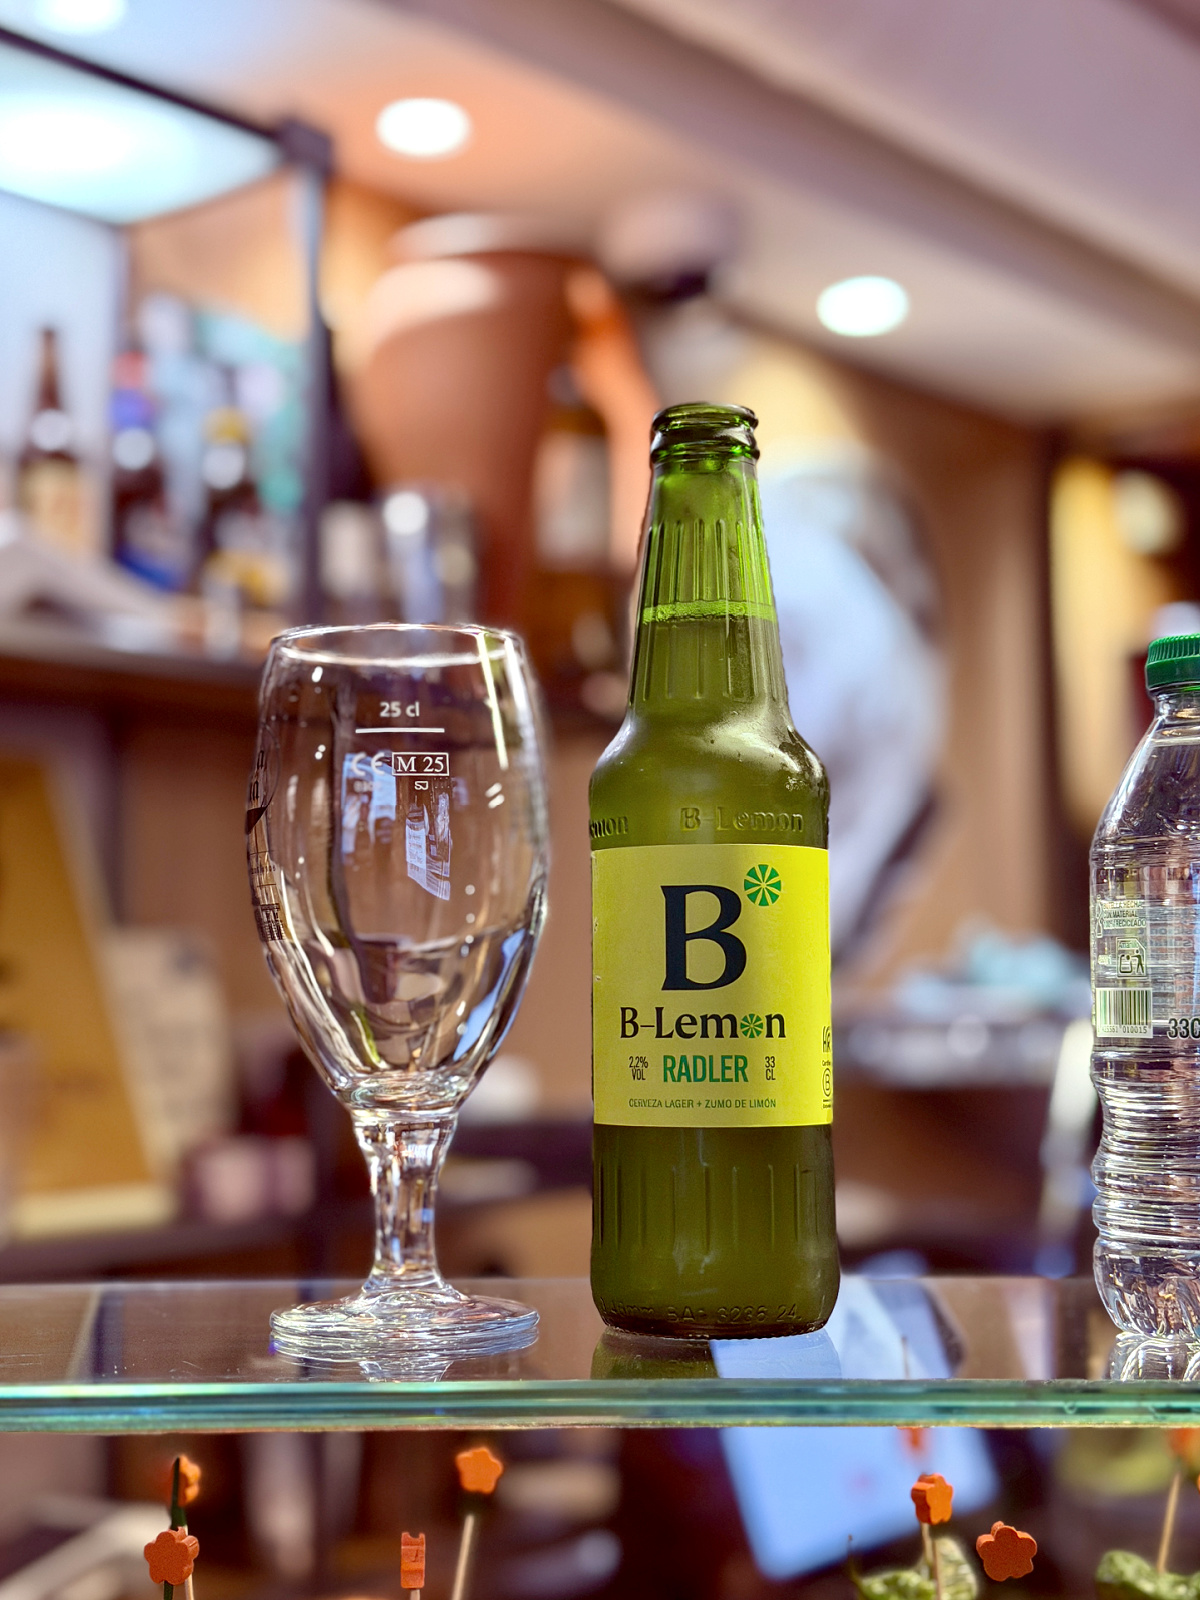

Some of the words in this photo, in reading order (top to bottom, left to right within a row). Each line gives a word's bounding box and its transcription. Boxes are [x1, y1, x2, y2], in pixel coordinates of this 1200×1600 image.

[380, 701, 401, 718] 25
[405, 701, 420, 718] cl
[396, 756, 417, 772] M
[422, 756, 444, 773] 25
[660, 884, 747, 991] B
[1122, 1025, 1148, 1035] 010015
[663, 1054, 749, 1083] RADLER
[765, 1056, 776, 1069] 33
[631, 1068, 646, 1081] VOL
[765, 1069, 776, 1081] CL
[629, 1098, 662, 1108] CERVEZA
[705, 1099, 732, 1108] ZUMO
[735, 1099, 747, 1108] DE
[749, 1098, 776, 1108] LIMÓN
